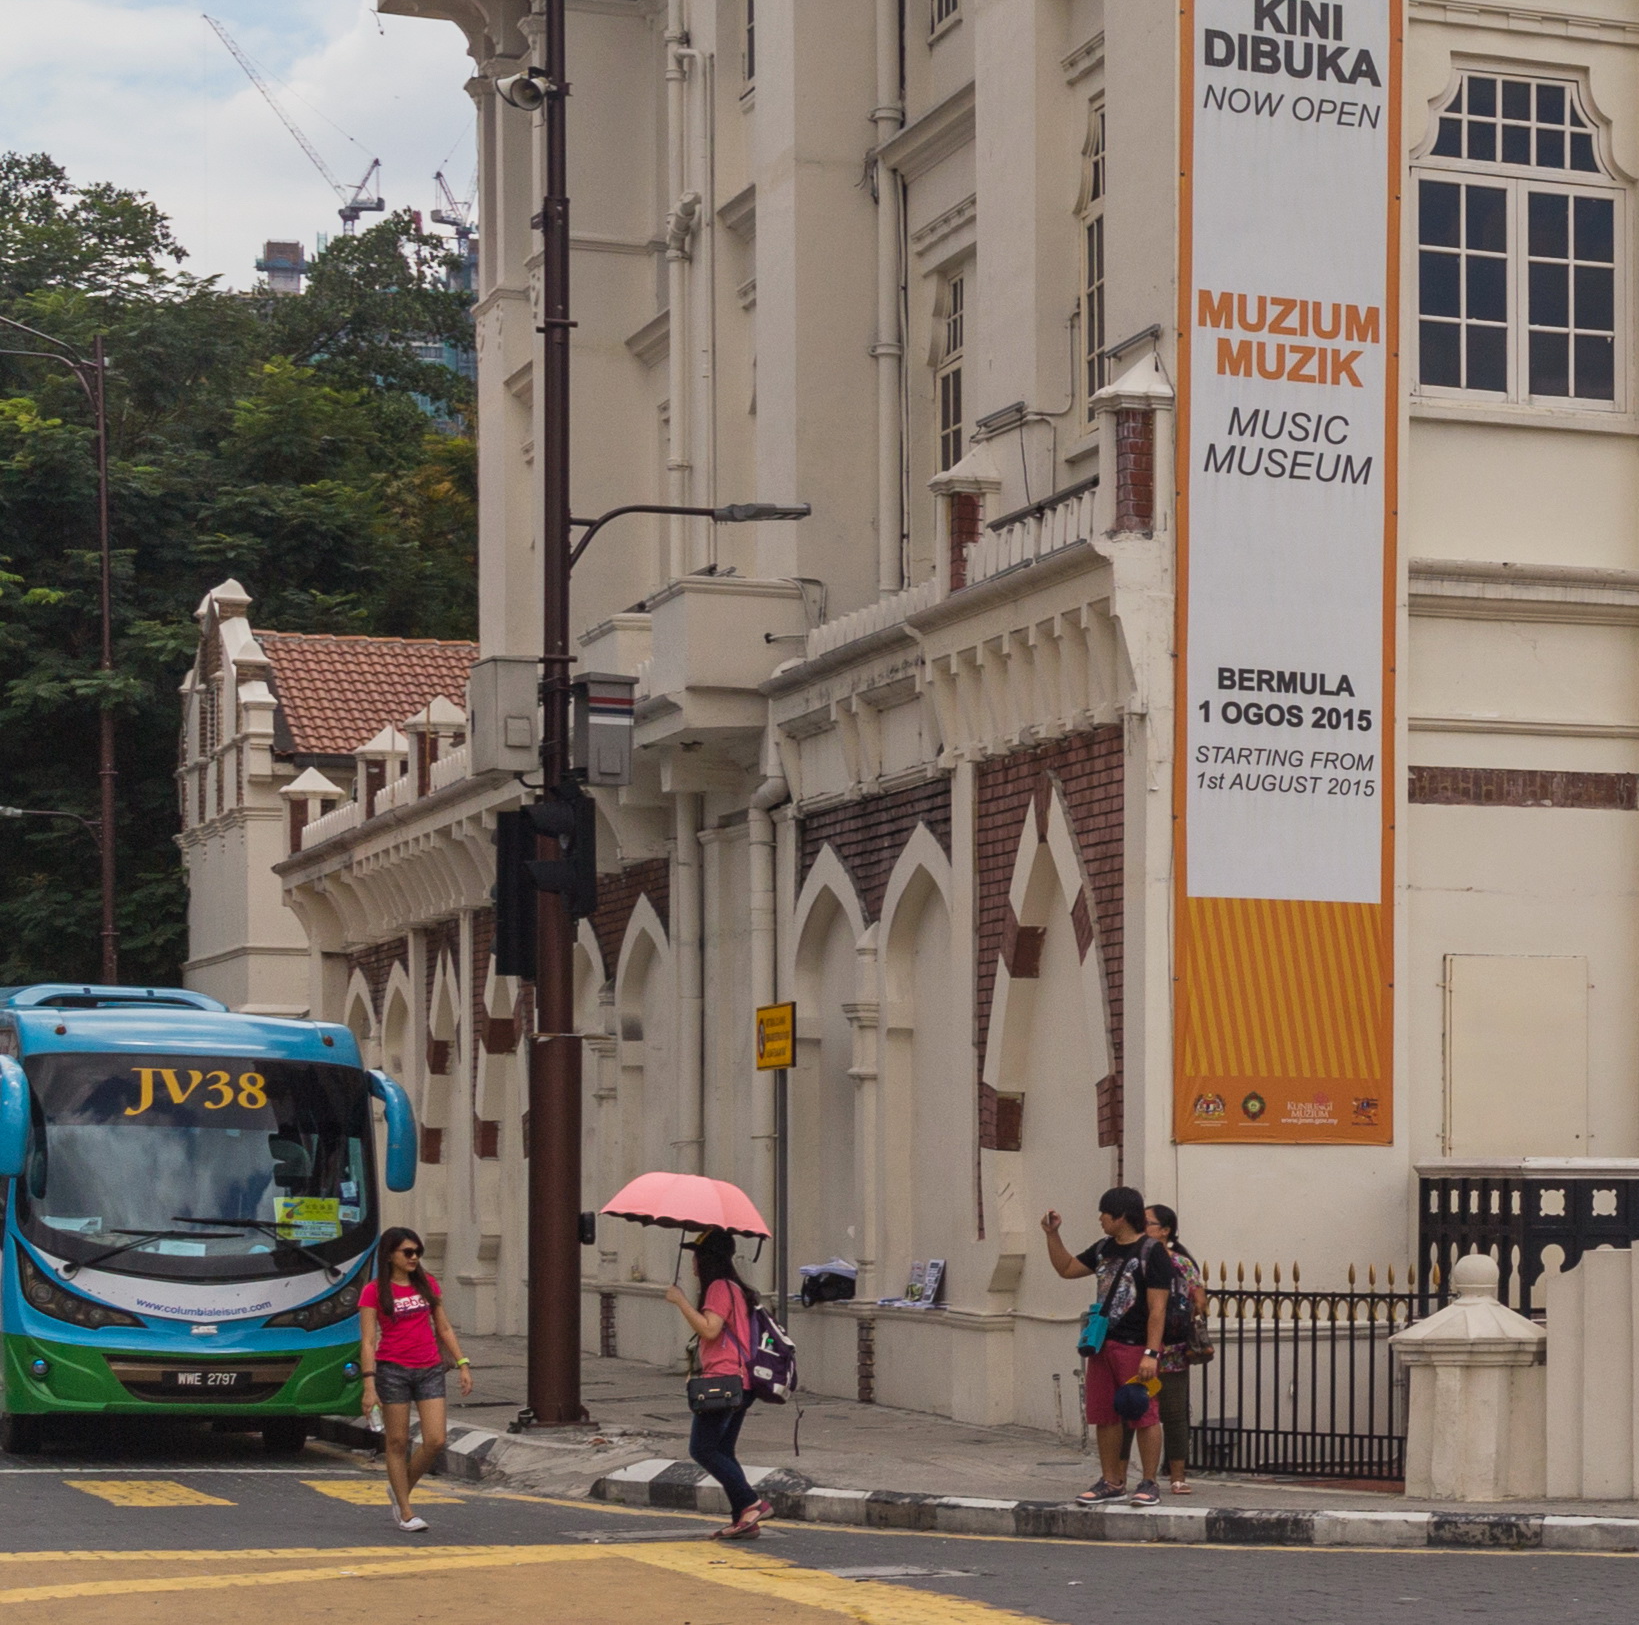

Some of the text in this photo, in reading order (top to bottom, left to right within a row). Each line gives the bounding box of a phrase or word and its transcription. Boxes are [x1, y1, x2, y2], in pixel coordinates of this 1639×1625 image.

[1204, 28, 1382, 87] DIBUKA
[1203, 84, 1381, 129] NOW OPEN
[1198, 289, 1380, 344] MUZIUM
[1217, 337, 1364, 388] MUZIK
[1227, 406, 1350, 445] MUSIC
[1203, 443, 1373, 485] MUSEUM
[1217, 667, 1356, 697] BERMULA
[1199, 700, 1372, 731] 1 OGOS 2015
[1195, 745, 1375, 771] STARTING FROM
[1197, 772, 1375, 797] 1st AUGUST 2015
[124, 1067, 268, 1116] JV38
[136, 1298, 272, 1317] www.columbialeisure.com
[178, 1372, 237, 1385] WWE 2797
